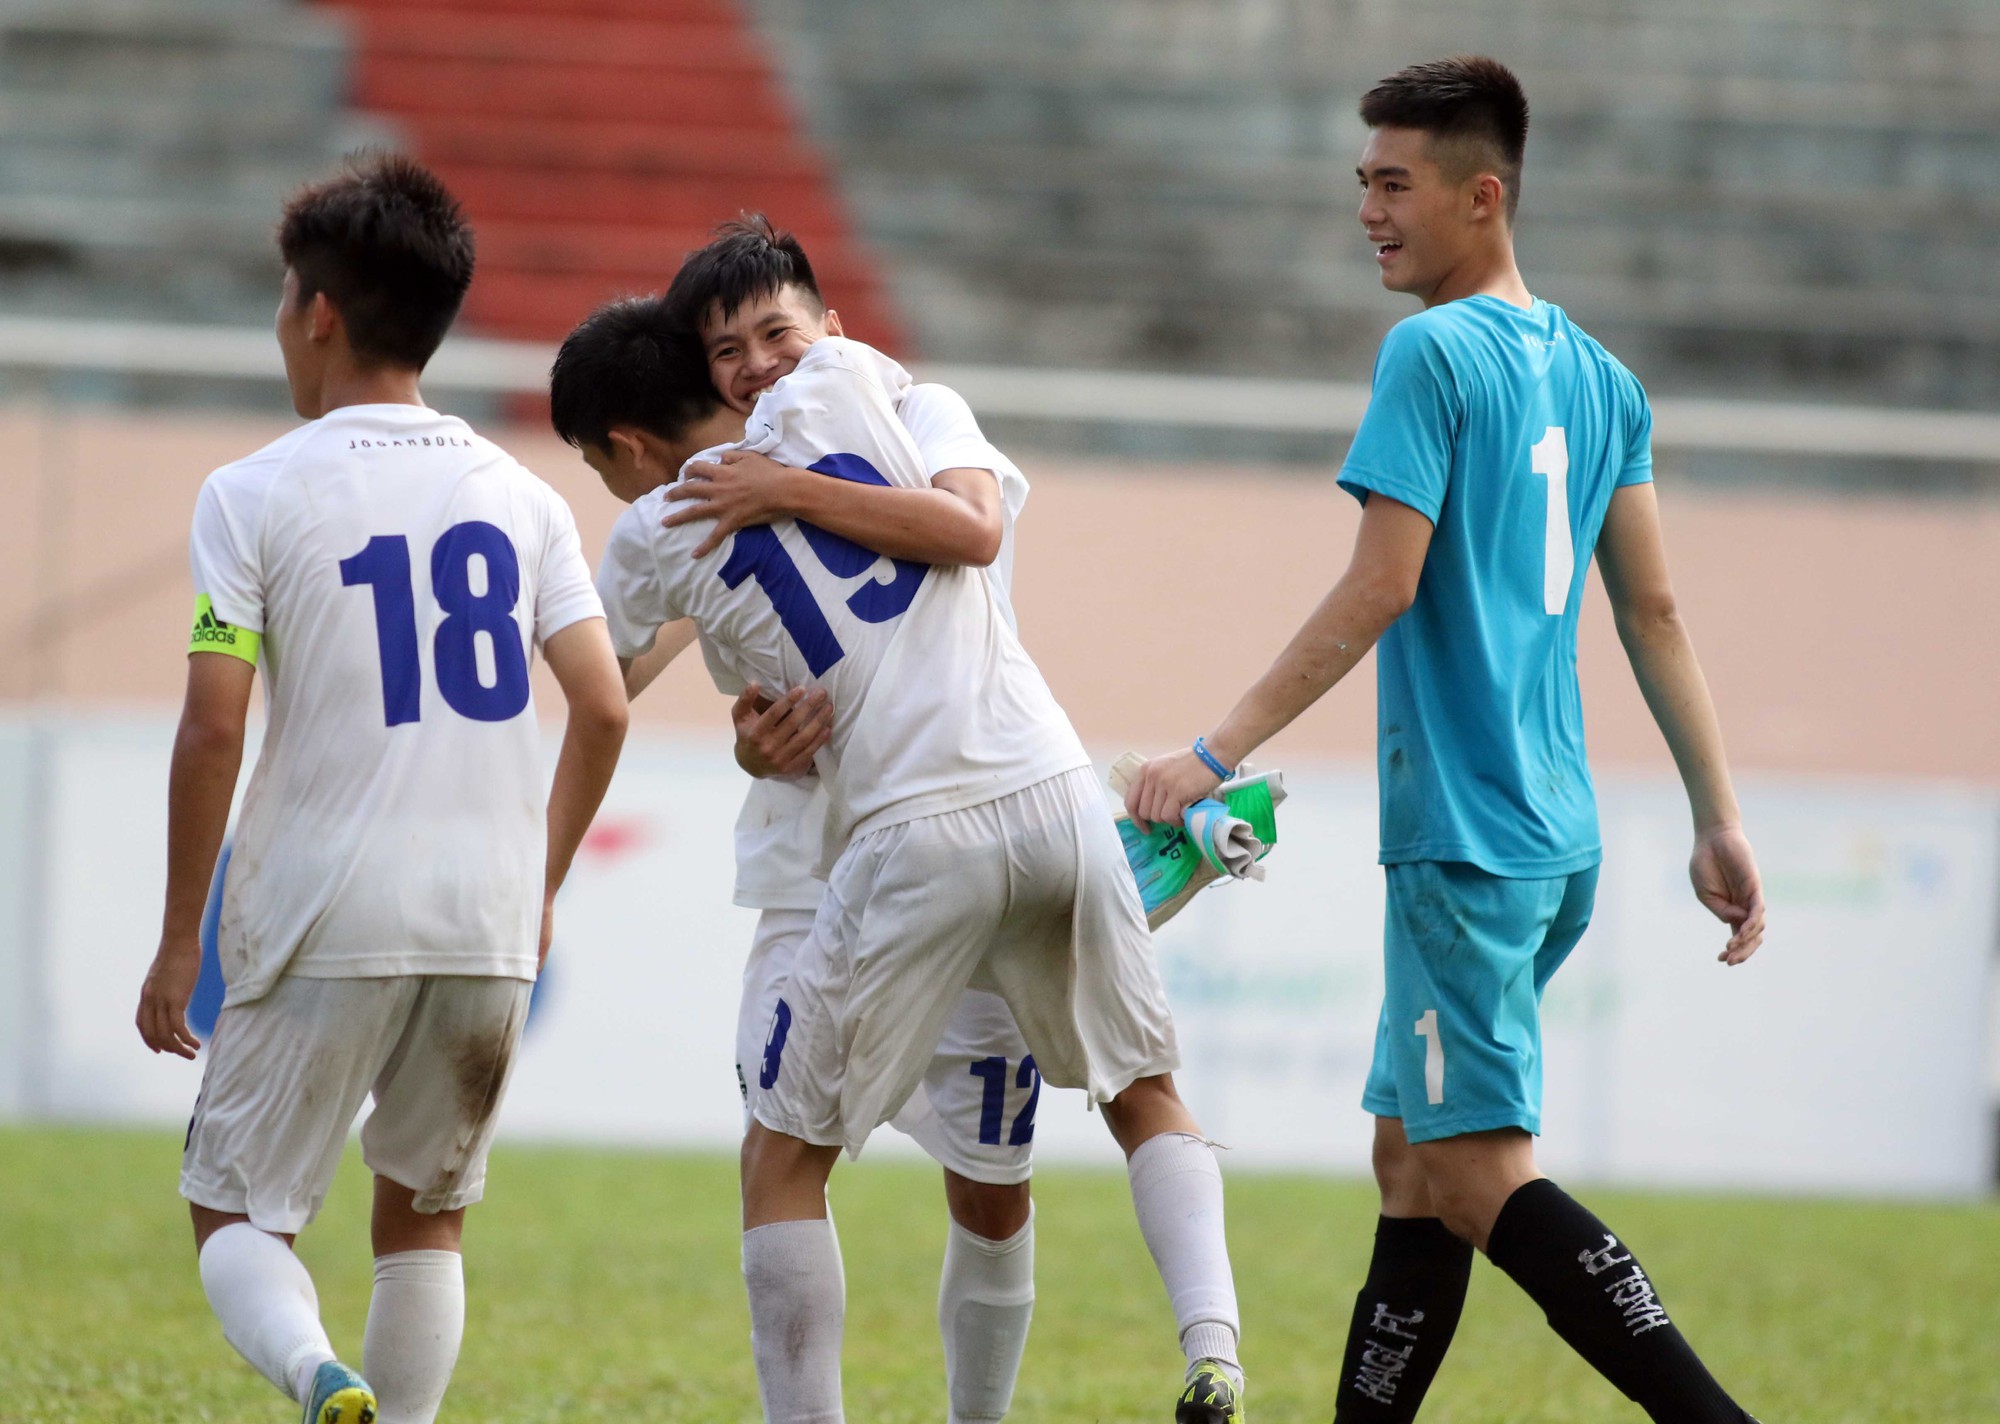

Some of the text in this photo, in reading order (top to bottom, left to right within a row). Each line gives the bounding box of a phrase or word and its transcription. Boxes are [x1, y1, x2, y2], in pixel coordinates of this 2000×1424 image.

[1531, 426, 1574, 615] 1
[191, 627, 236, 644] didas
[339, 521, 530, 727] 18
[969, 1054, 1041, 1146] 12
[1414, 1009, 1445, 1105] 1
